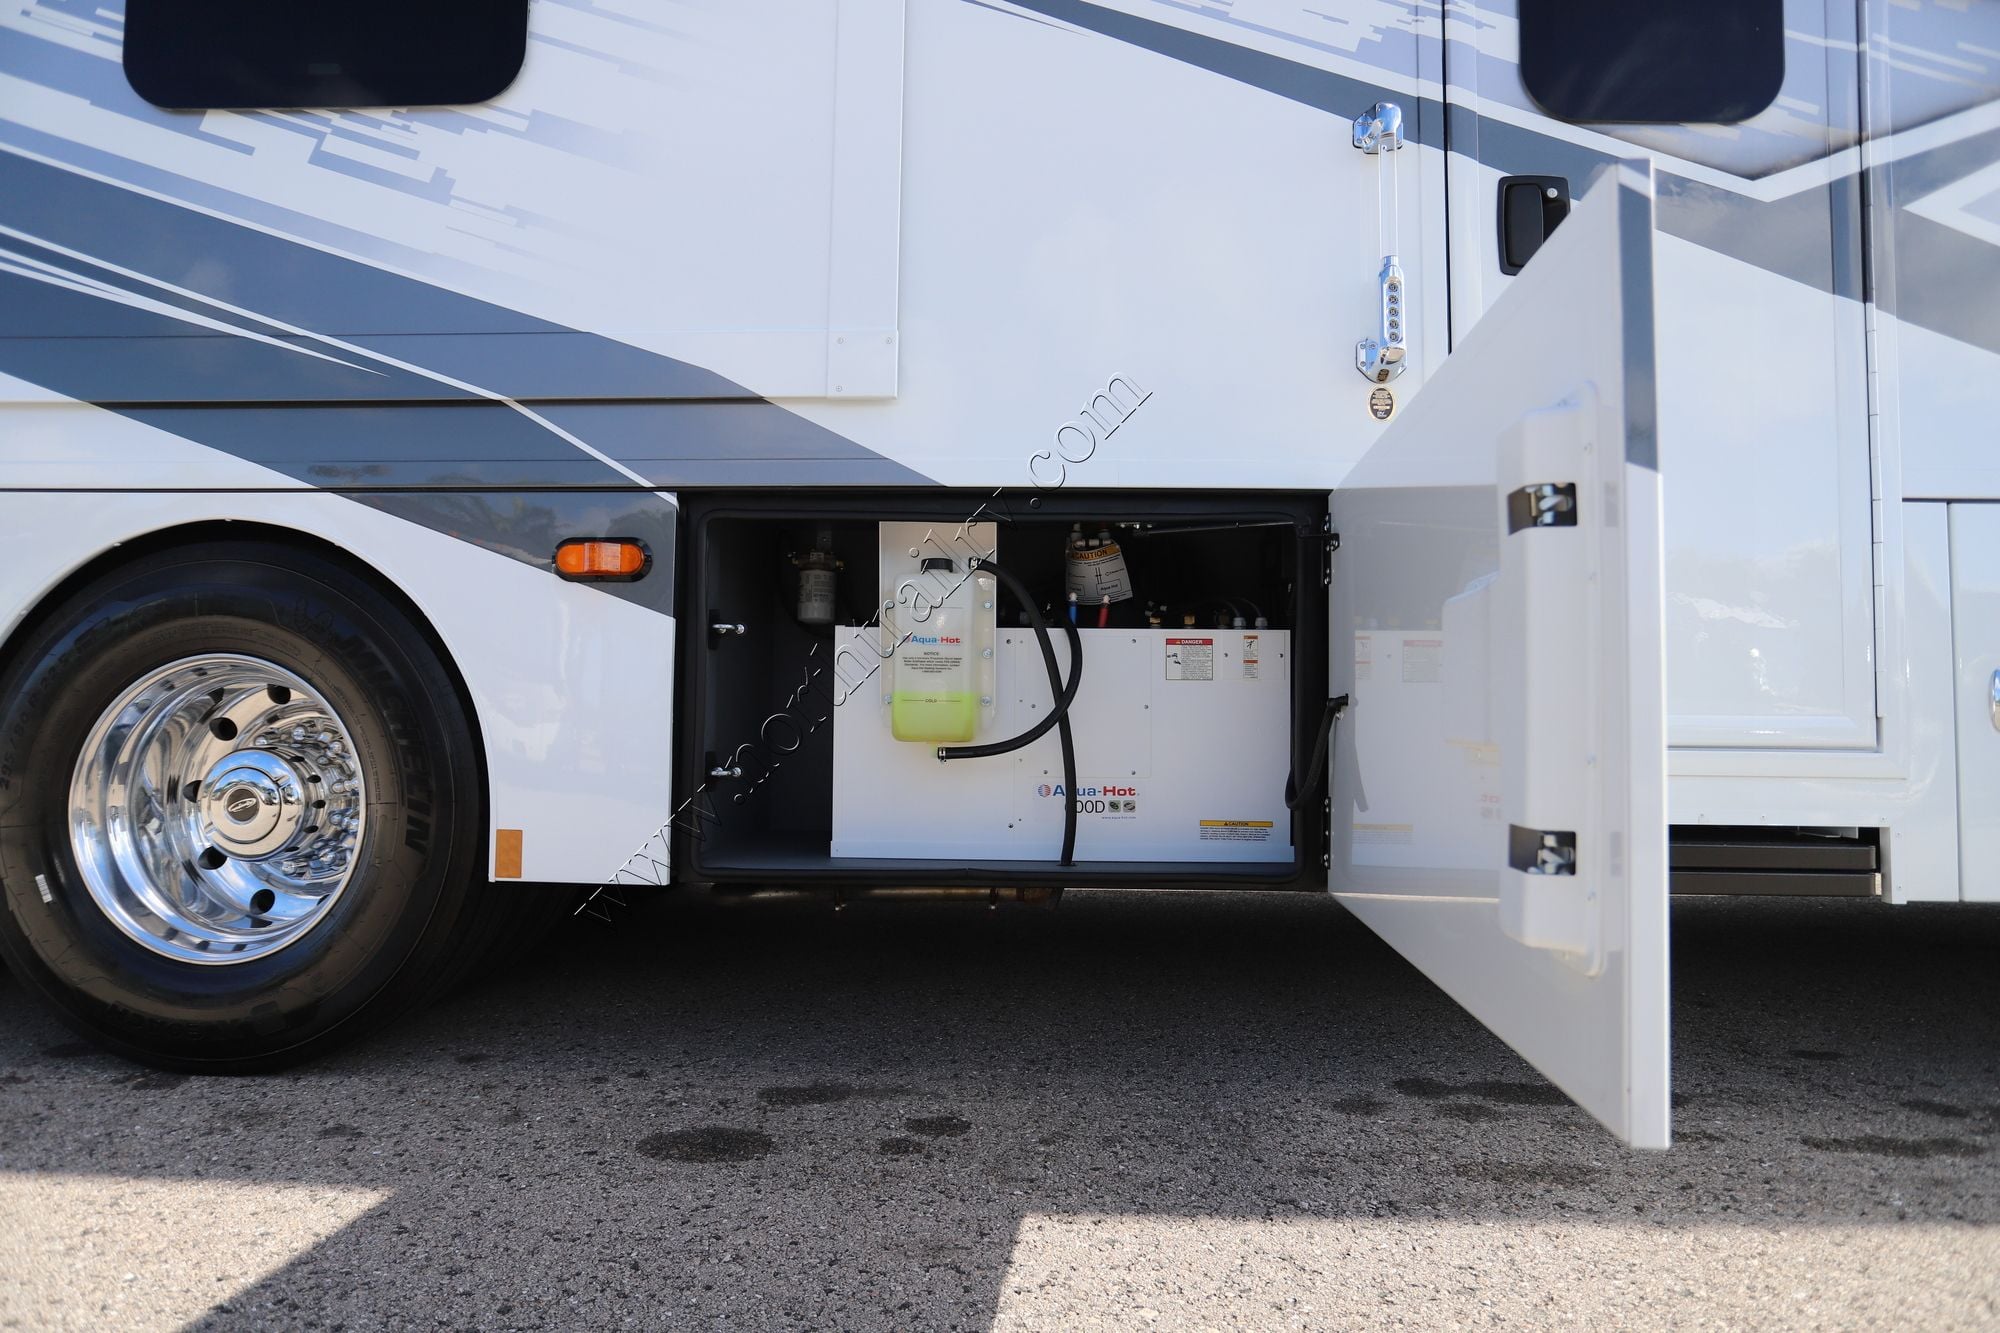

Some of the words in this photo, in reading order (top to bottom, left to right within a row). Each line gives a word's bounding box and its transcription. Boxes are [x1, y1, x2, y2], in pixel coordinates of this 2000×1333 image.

[1074, 549, 1108, 560] CAUTION
[911, 635, 961, 644] Aqua-Hot
[337, 633, 433, 855] MICHELIN
[1053, 784, 1136, 797] Aua-Hot
[1065, 800, 1105, 813] 00D
